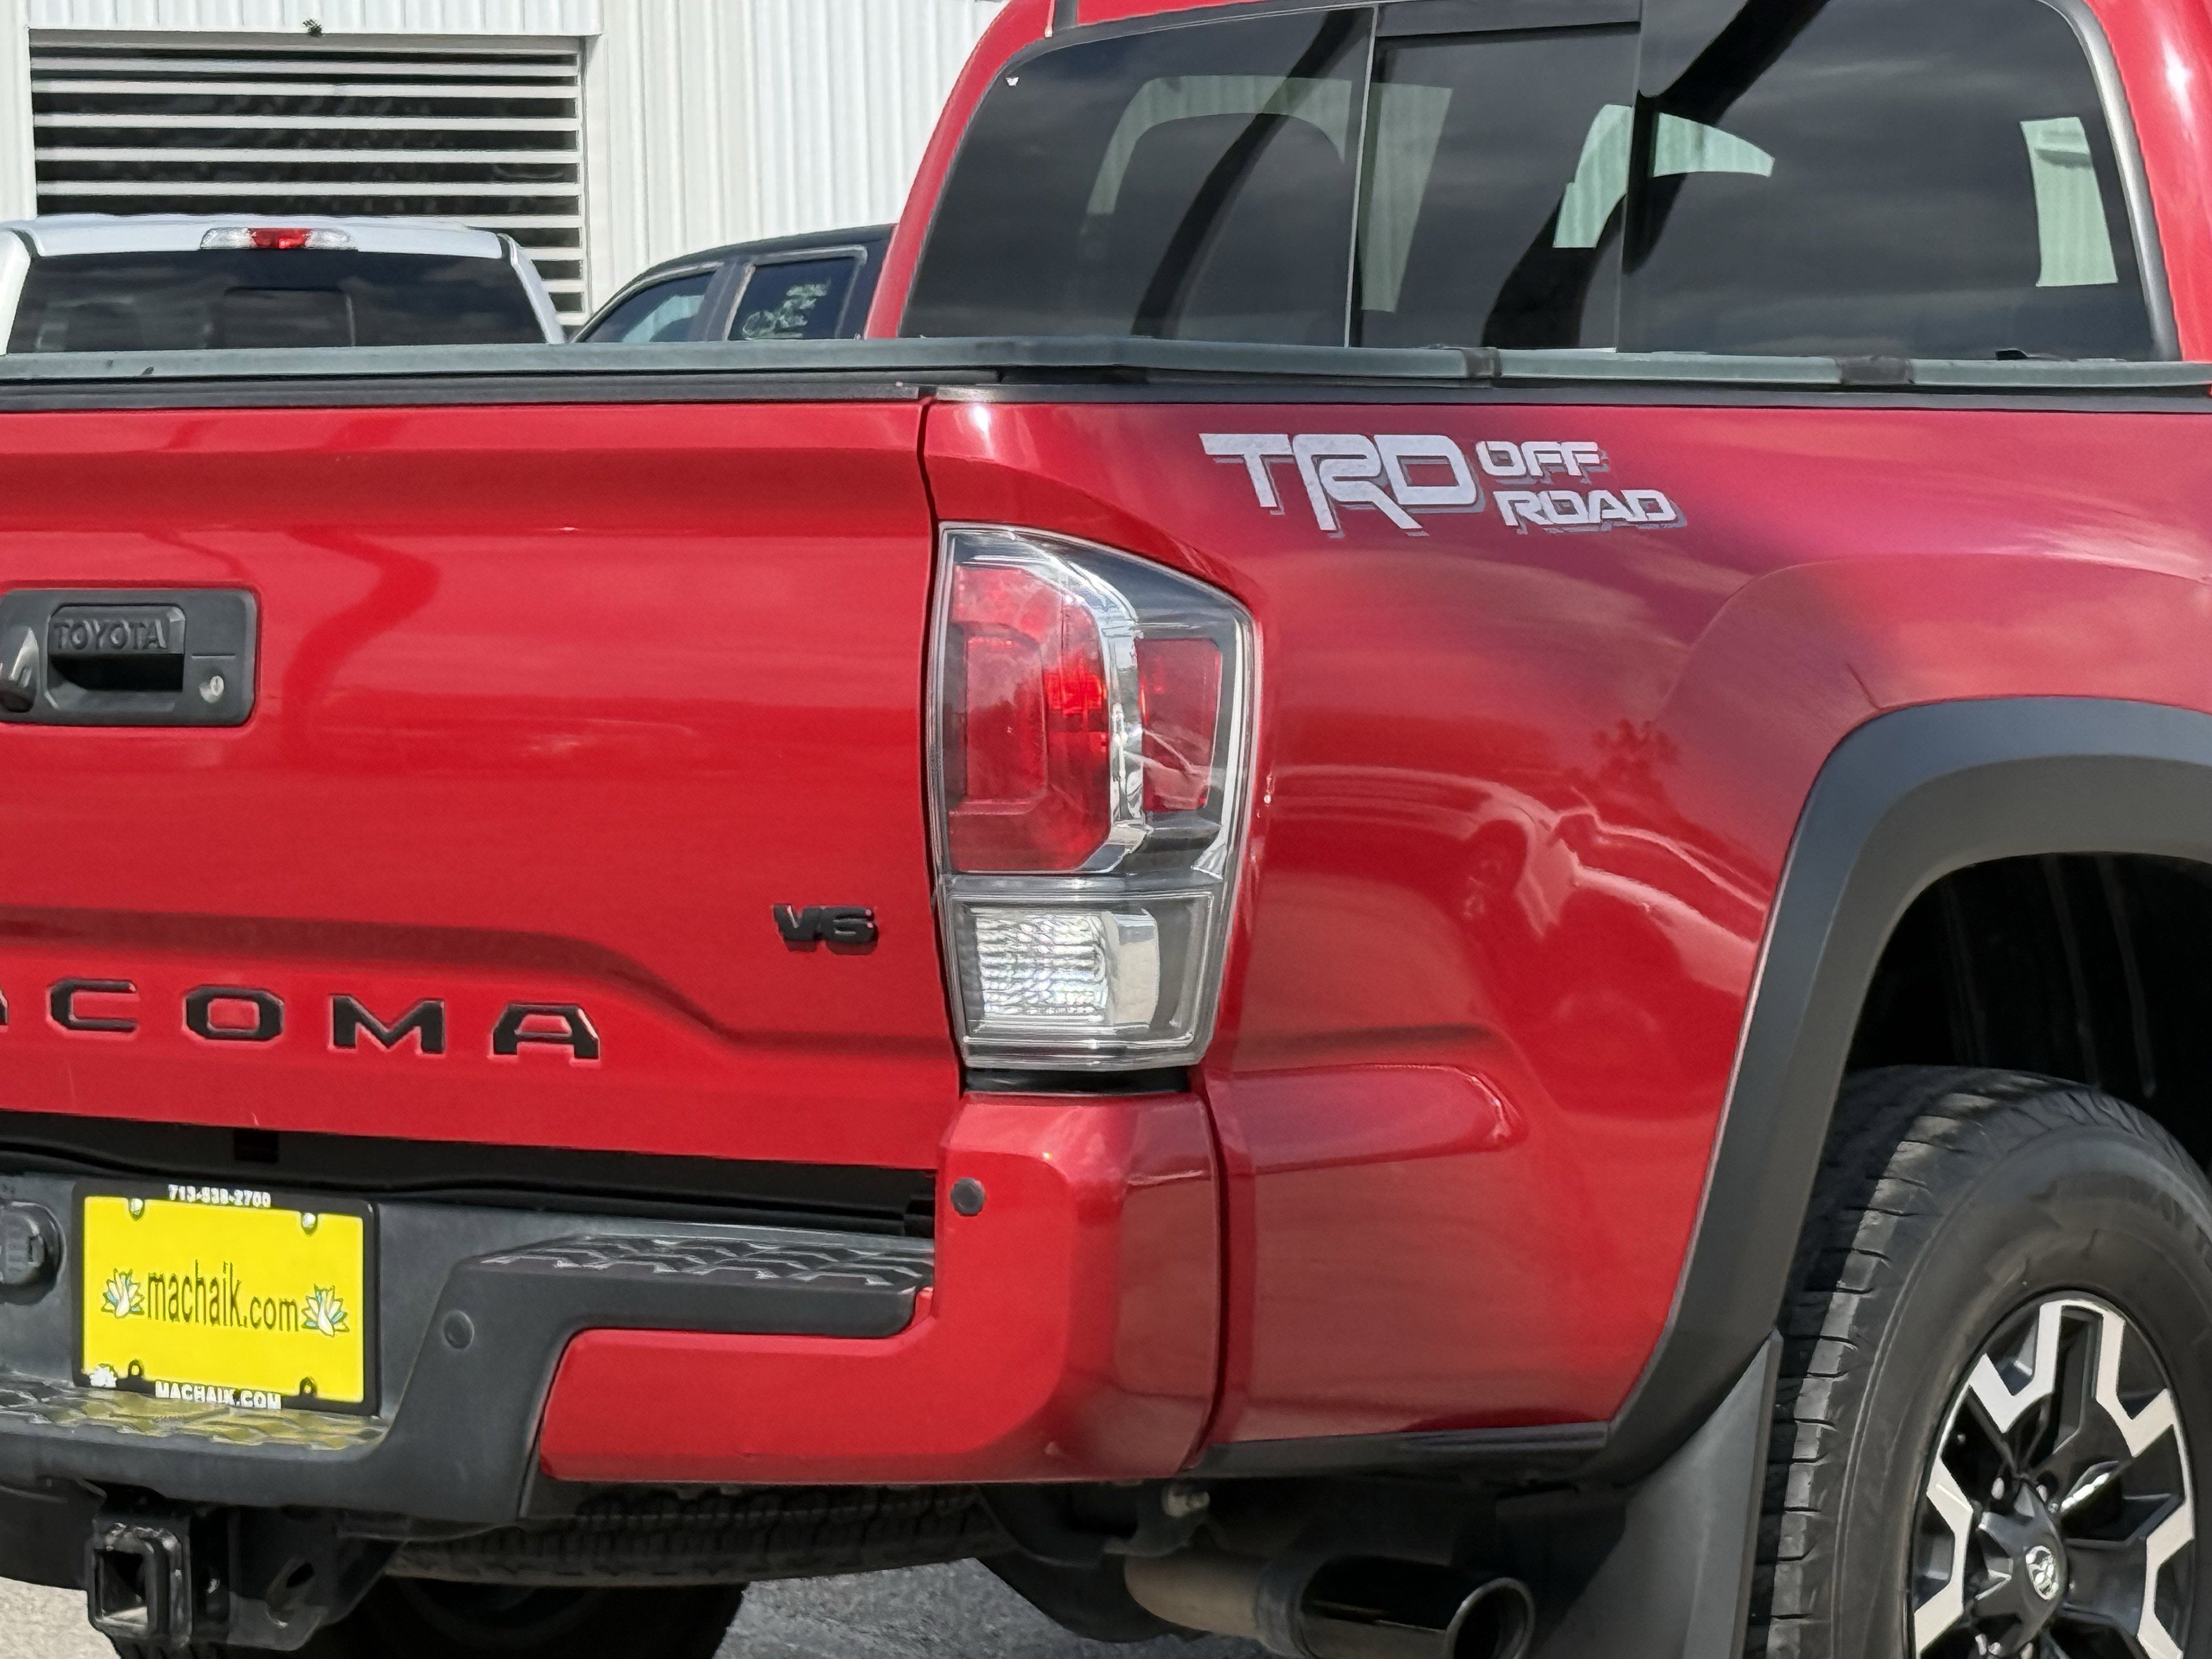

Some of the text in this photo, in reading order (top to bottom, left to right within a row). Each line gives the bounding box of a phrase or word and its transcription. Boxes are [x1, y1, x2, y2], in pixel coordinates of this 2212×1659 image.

[1476, 441, 1609, 484] OFF
[1199, 433, 1485, 538] TRD
[1492, 489, 1688, 535] ROAD
[54, 618, 167, 650] TOYOTA
[772, 904, 878, 945] V6
[0, 978, 600, 1059] COMA
[147, 1259, 299, 1331] machaik.com
[155, 1380, 281, 1410] MACHAIK.COM
